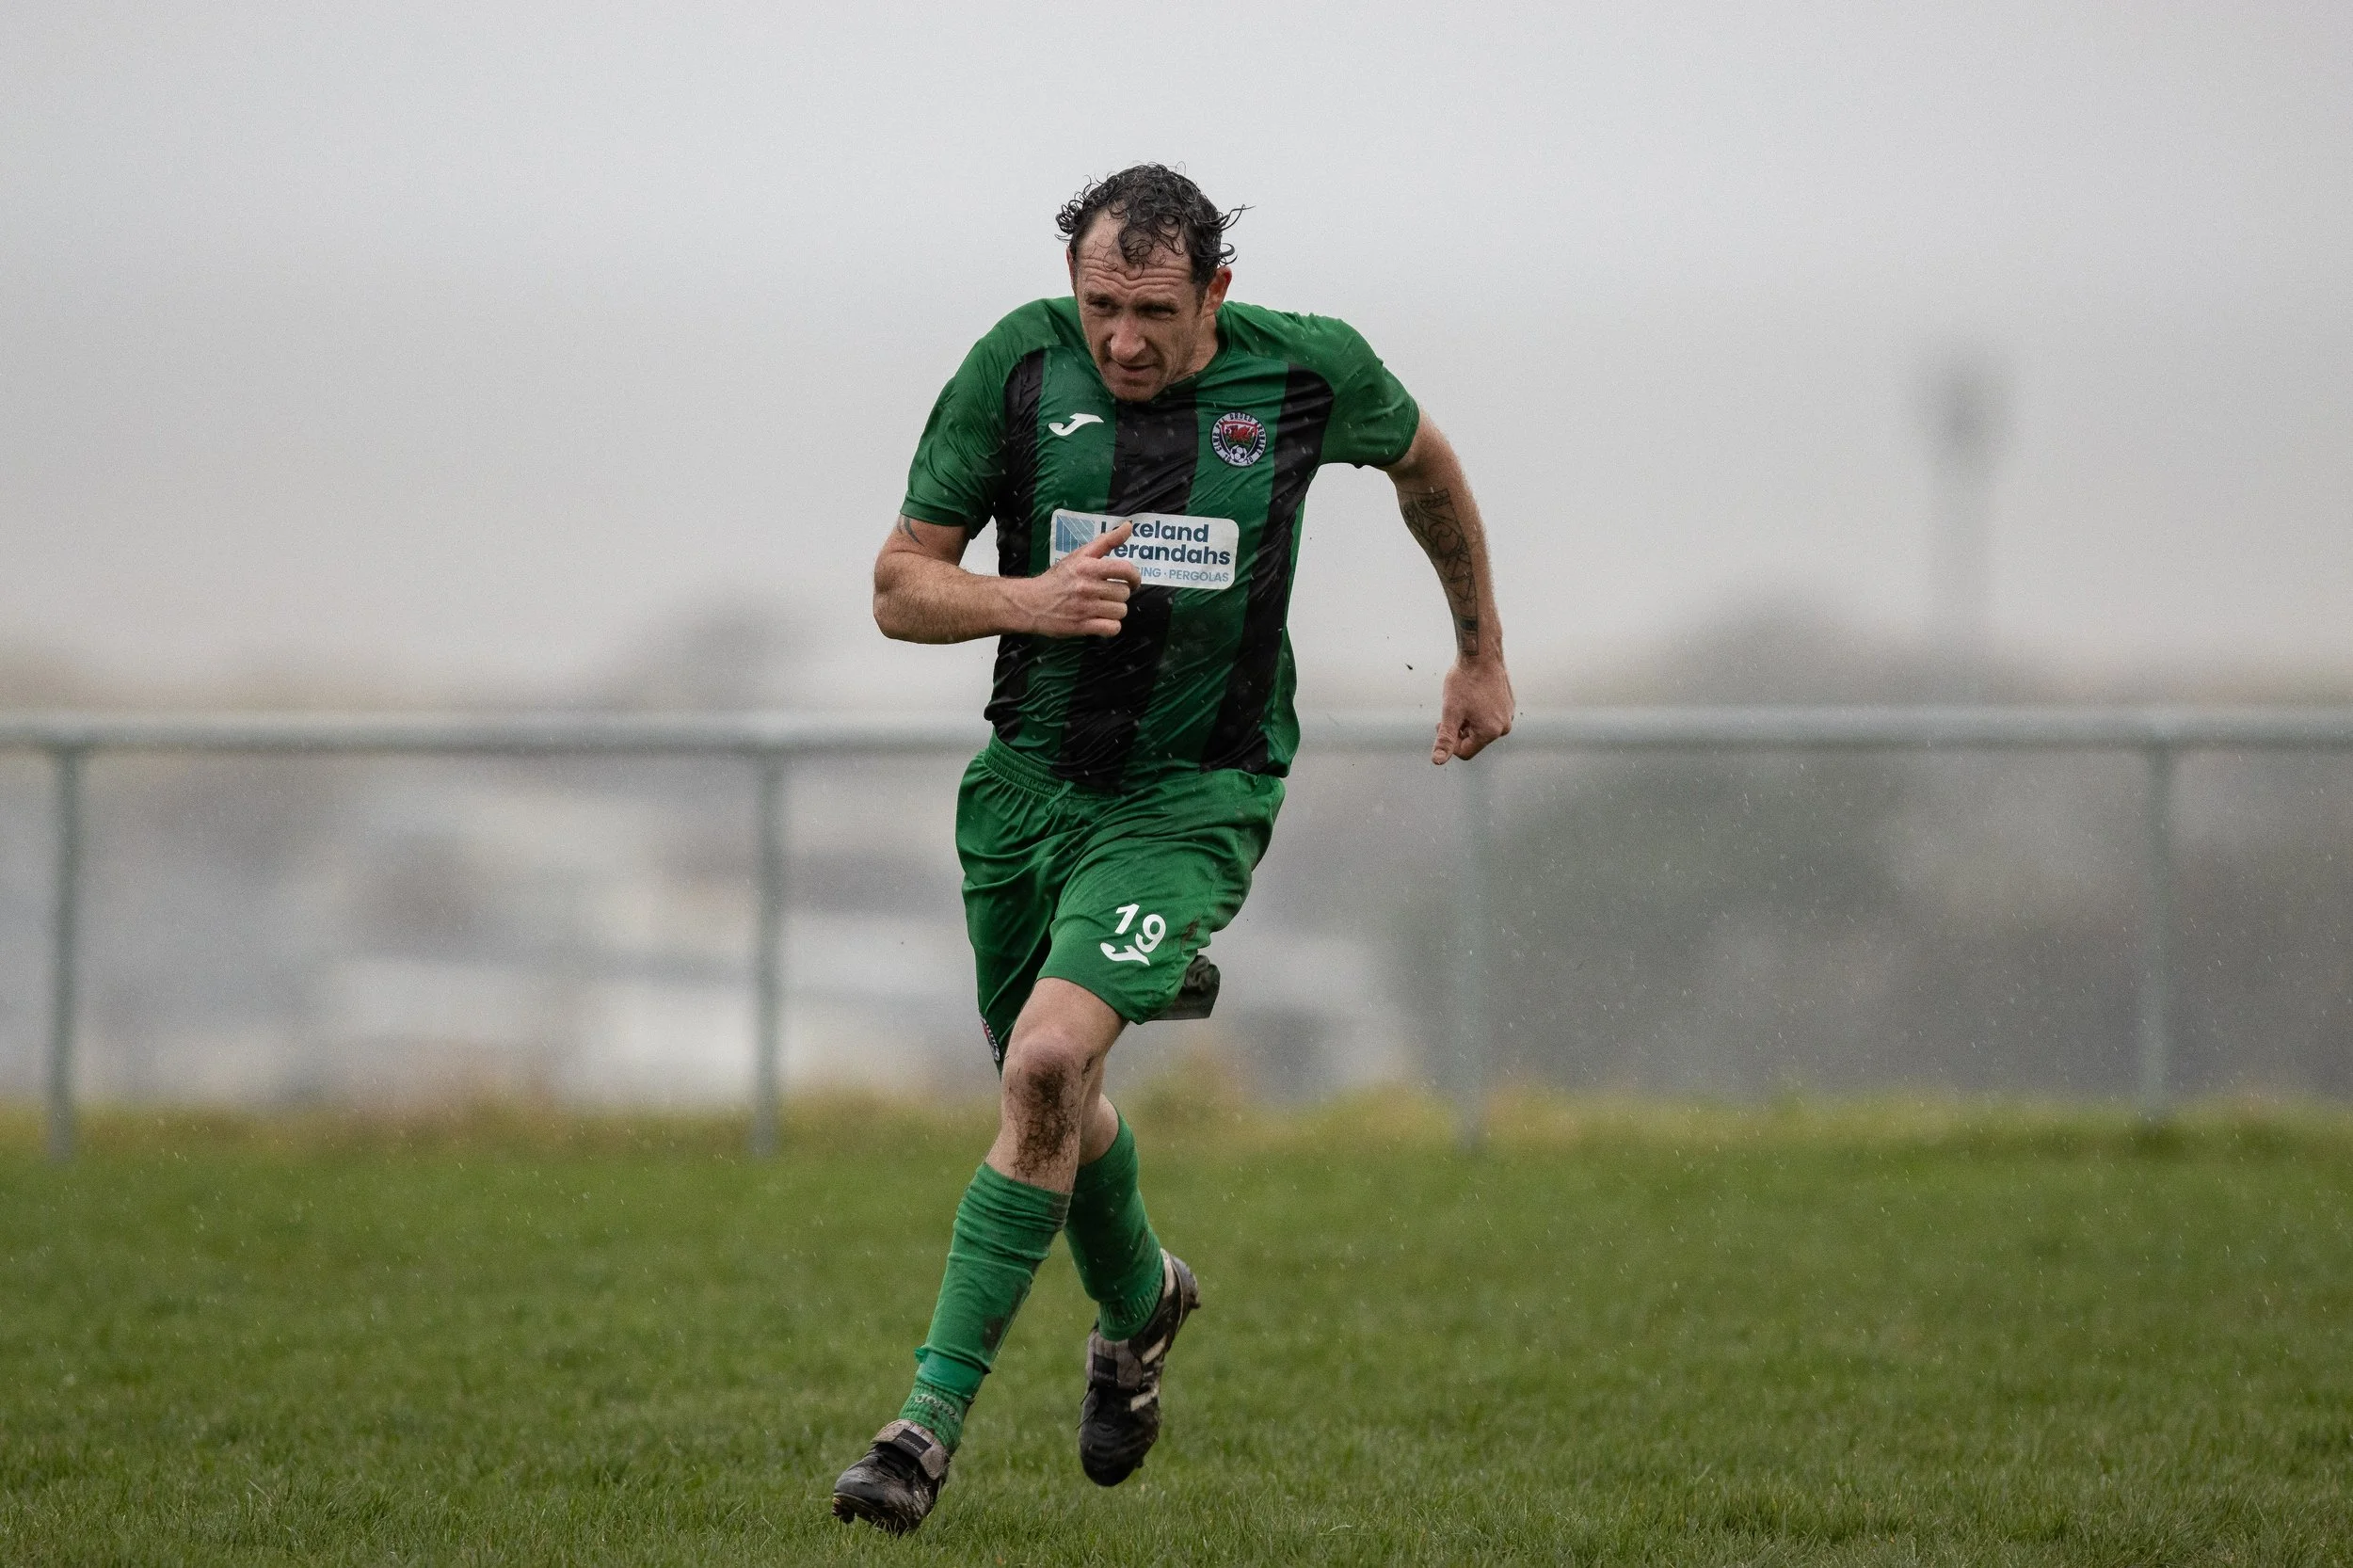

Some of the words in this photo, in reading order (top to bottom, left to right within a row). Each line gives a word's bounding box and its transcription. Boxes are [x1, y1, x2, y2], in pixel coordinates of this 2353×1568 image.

[1101, 520, 1209, 543] Lkeland
[1104, 543, 1231, 565] erandahs
[1169, 569, 1229, 583] PERGOLAS
[1114, 904, 1166, 952] 19
